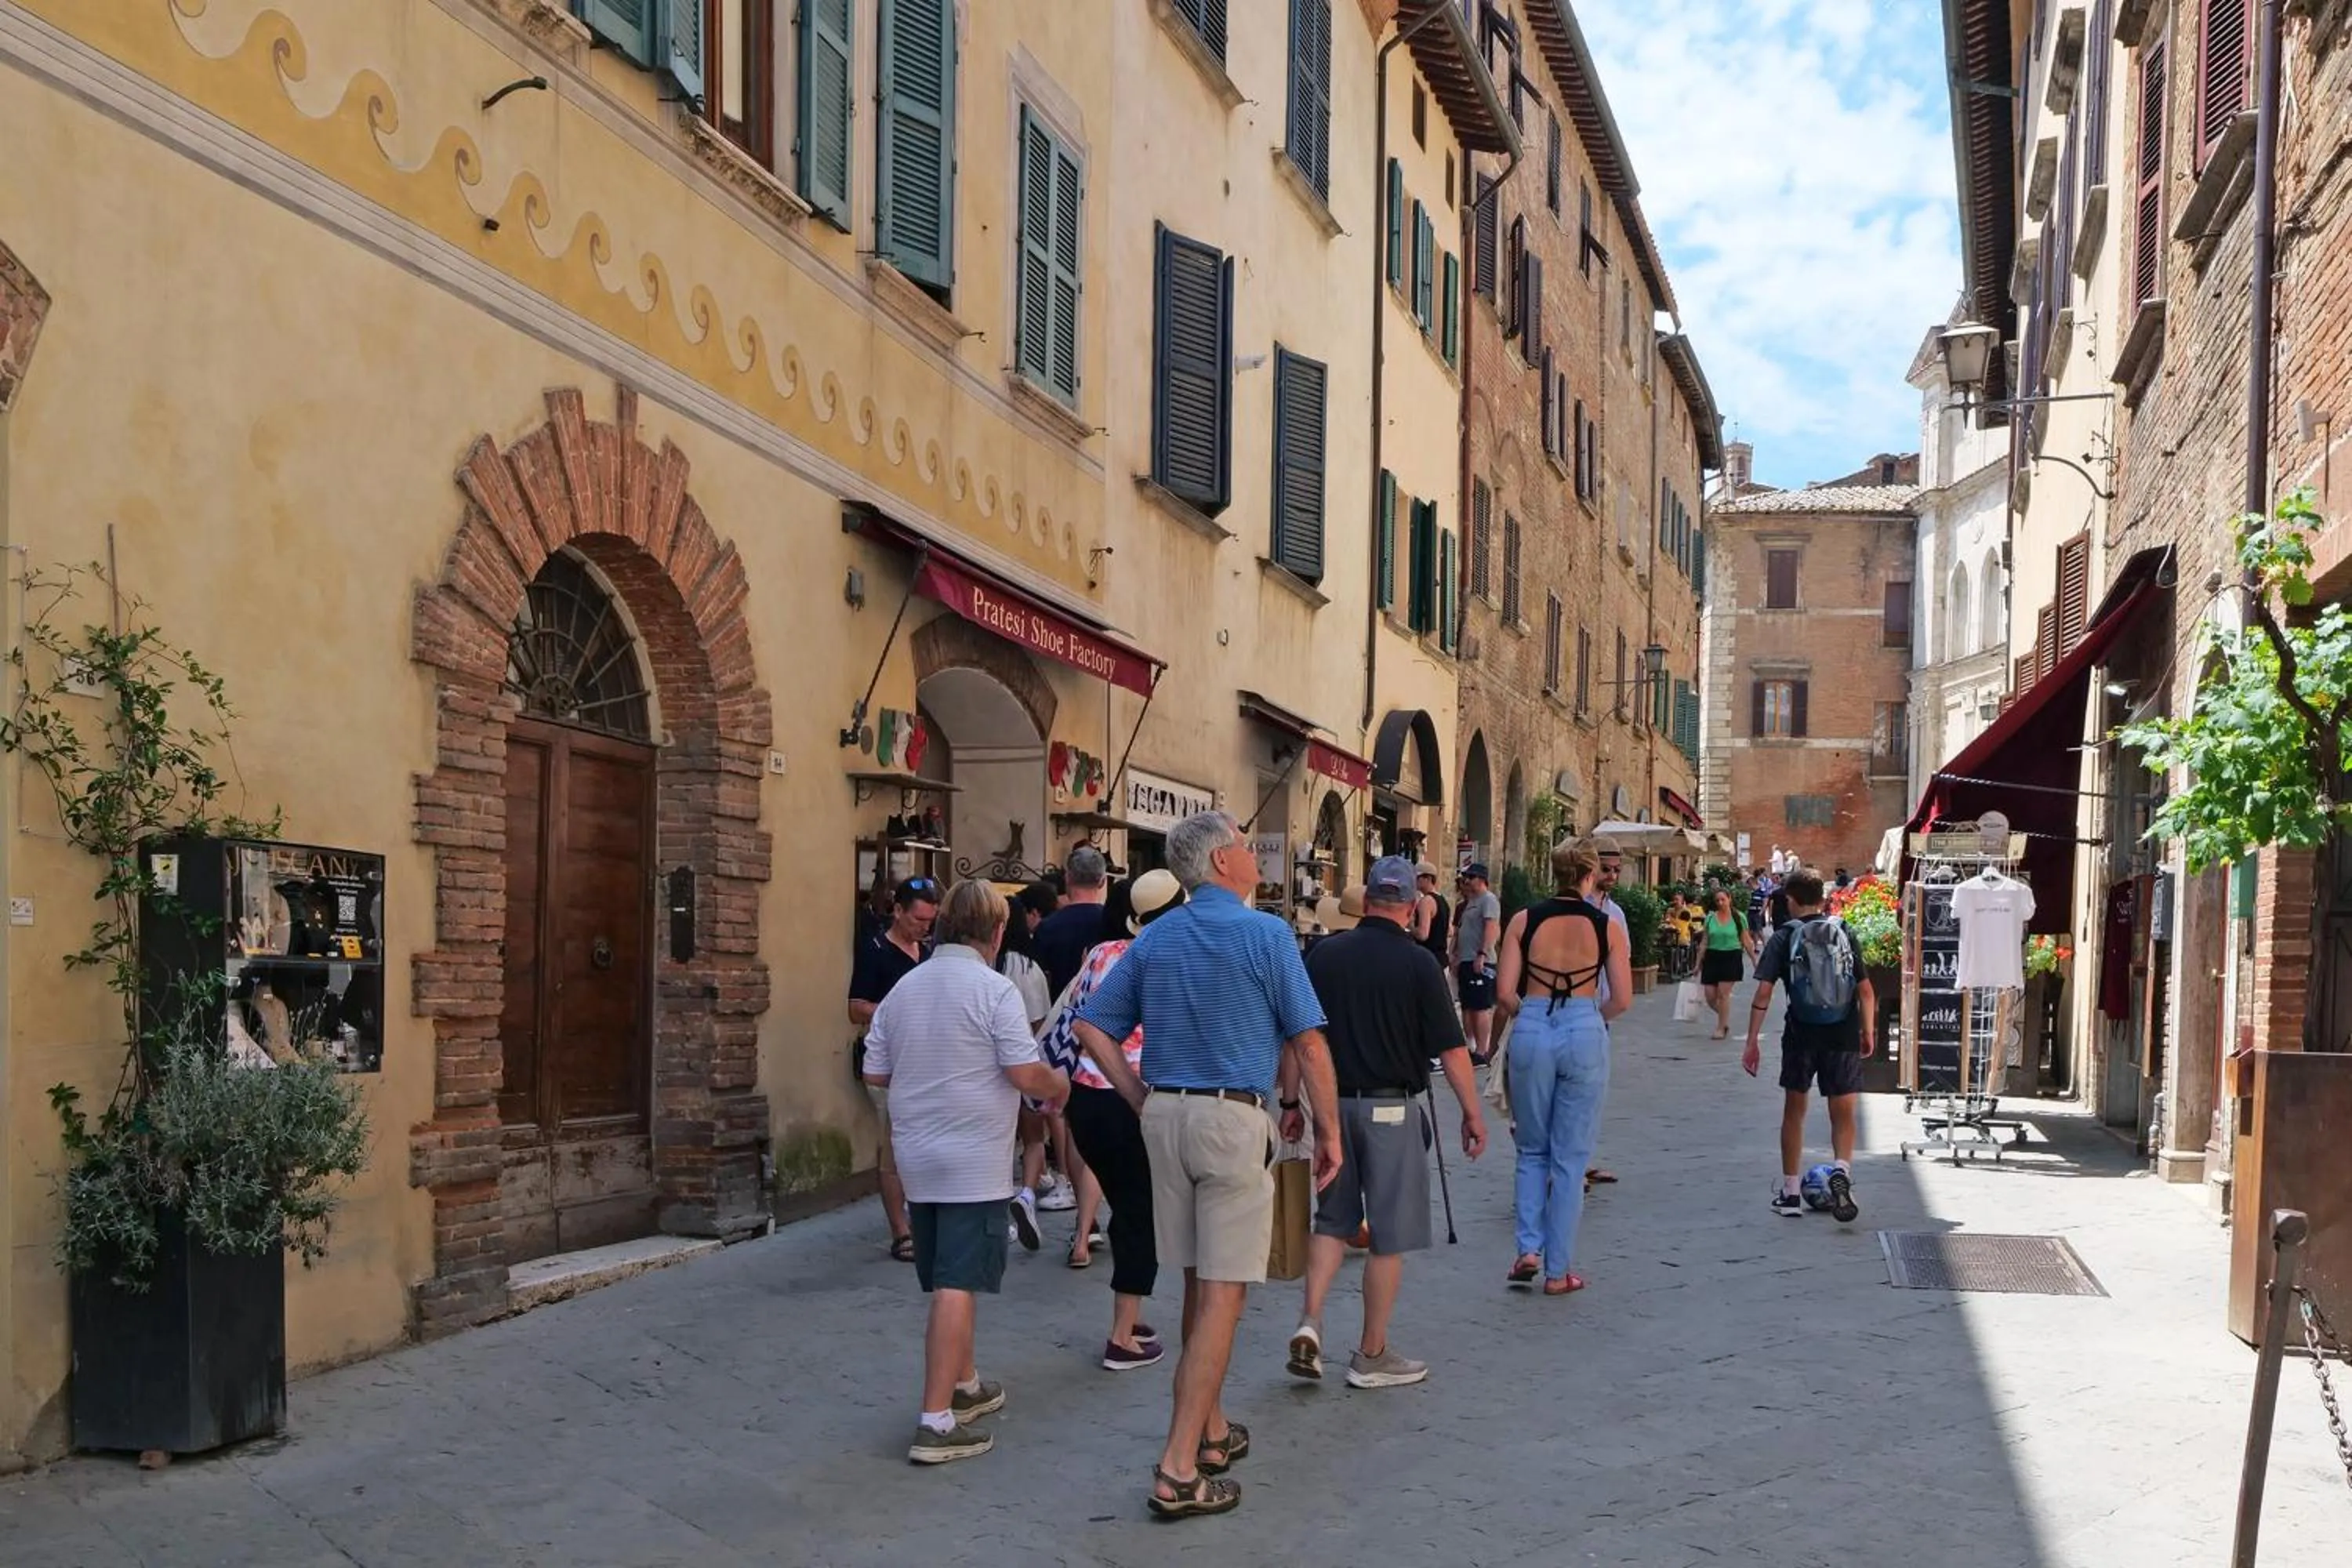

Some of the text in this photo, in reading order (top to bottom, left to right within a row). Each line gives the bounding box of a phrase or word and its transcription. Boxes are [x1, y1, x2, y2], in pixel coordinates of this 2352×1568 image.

[973, 586, 1116, 680] Pratesi Shoe Factory
[76, 668, 95, 686] 56
